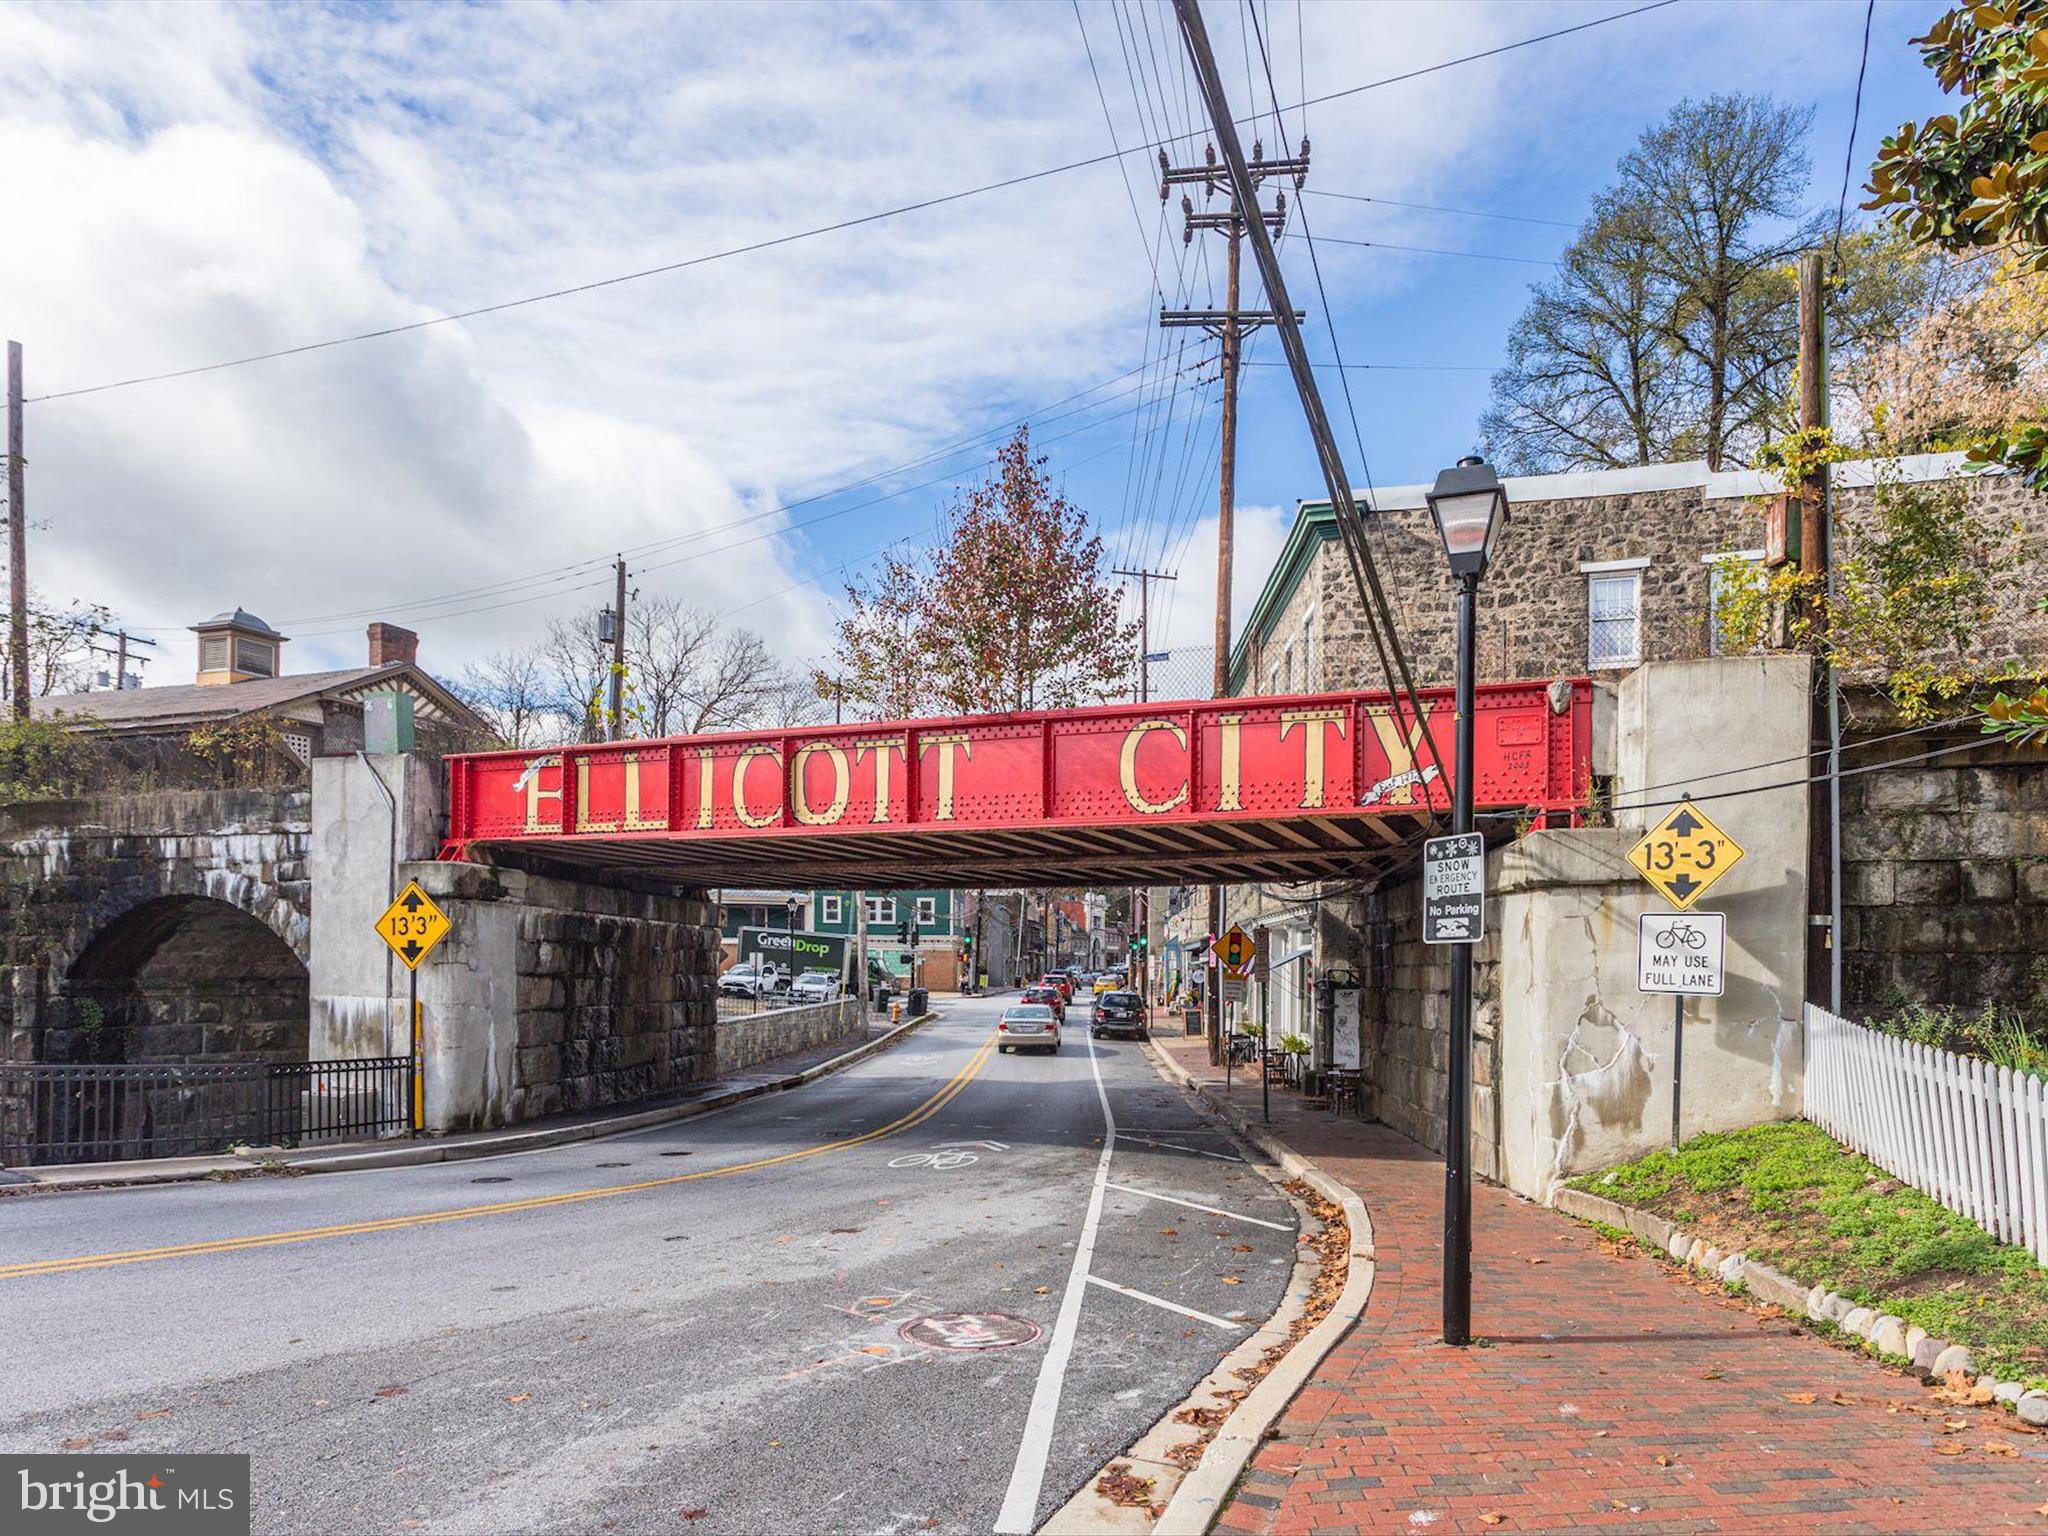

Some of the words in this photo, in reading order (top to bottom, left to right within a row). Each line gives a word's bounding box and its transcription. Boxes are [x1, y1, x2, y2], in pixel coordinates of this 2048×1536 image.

[523, 732, 972, 835] ELLICOTT
[1118, 702, 1437, 814] CITY
[1437, 859, 1470, 873] SNOW
[1437, 882, 1470, 894] ROUTE
[1429, 905, 1442, 916] No
[1445, 903, 1479, 916] Parking
[1653, 955, 1678, 967] MAY
[1684, 956, 1709, 968] USE
[1645, 972, 1675, 986] FULL
[1682, 974, 1714, 987] LANE
